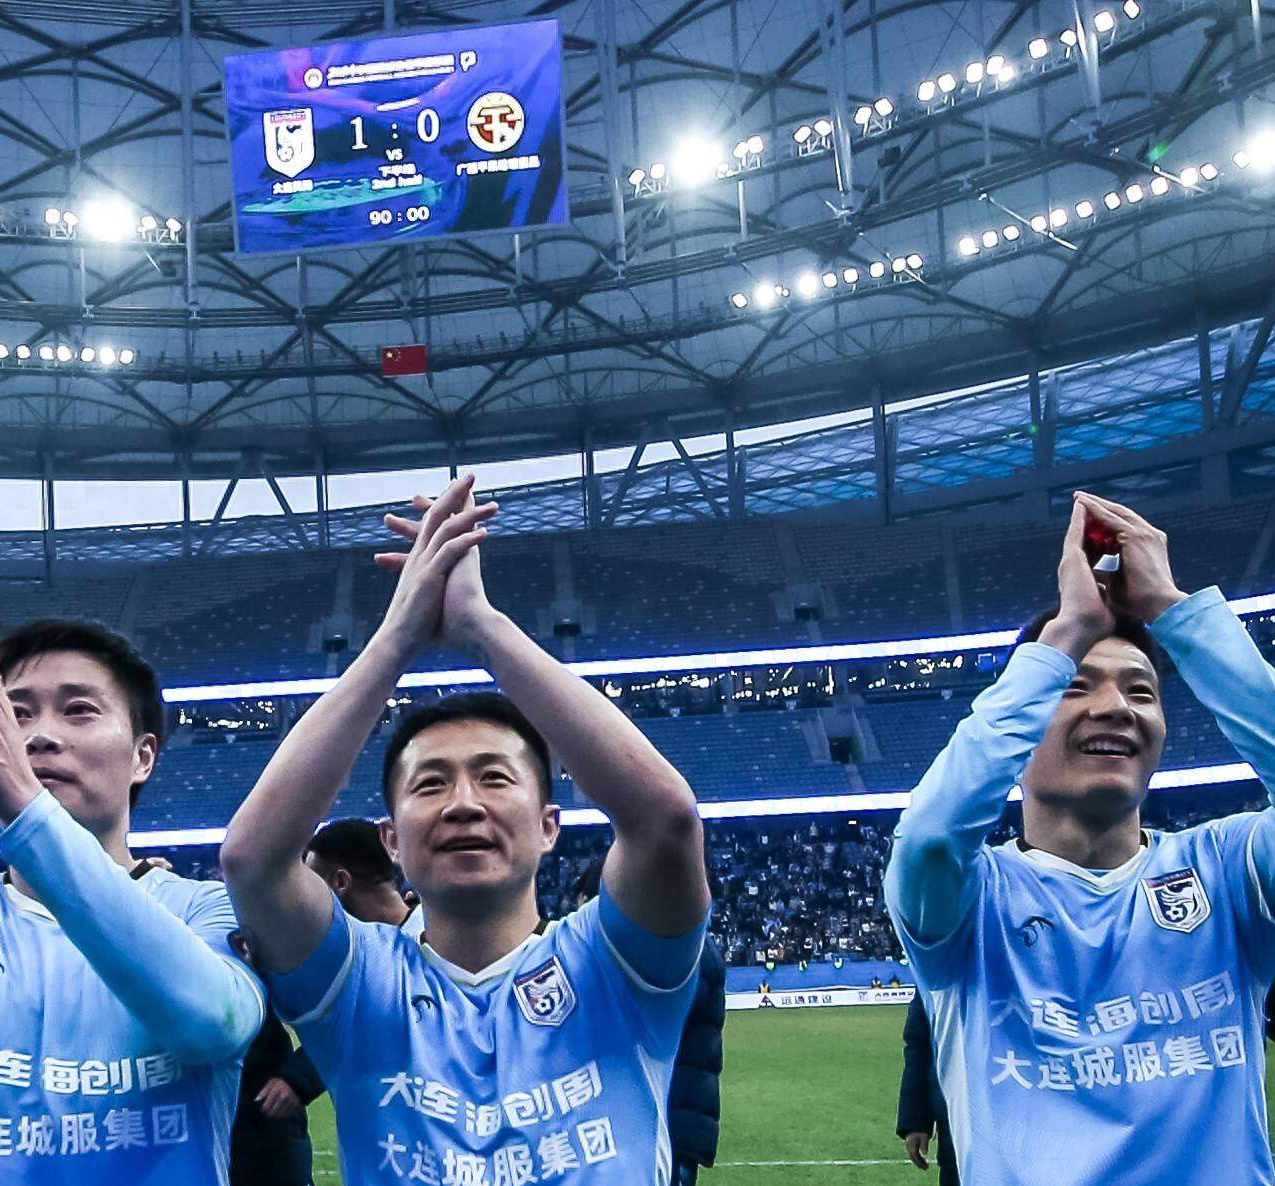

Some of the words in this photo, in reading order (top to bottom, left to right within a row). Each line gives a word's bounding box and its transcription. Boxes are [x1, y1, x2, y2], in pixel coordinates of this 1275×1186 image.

[350, 116, 368, 150] 1
[417, 108, 440, 142] 0
[991, 1025, 1246, 1091] 大连城服集团
[378, 1060, 603, 1136] 大连海创周
